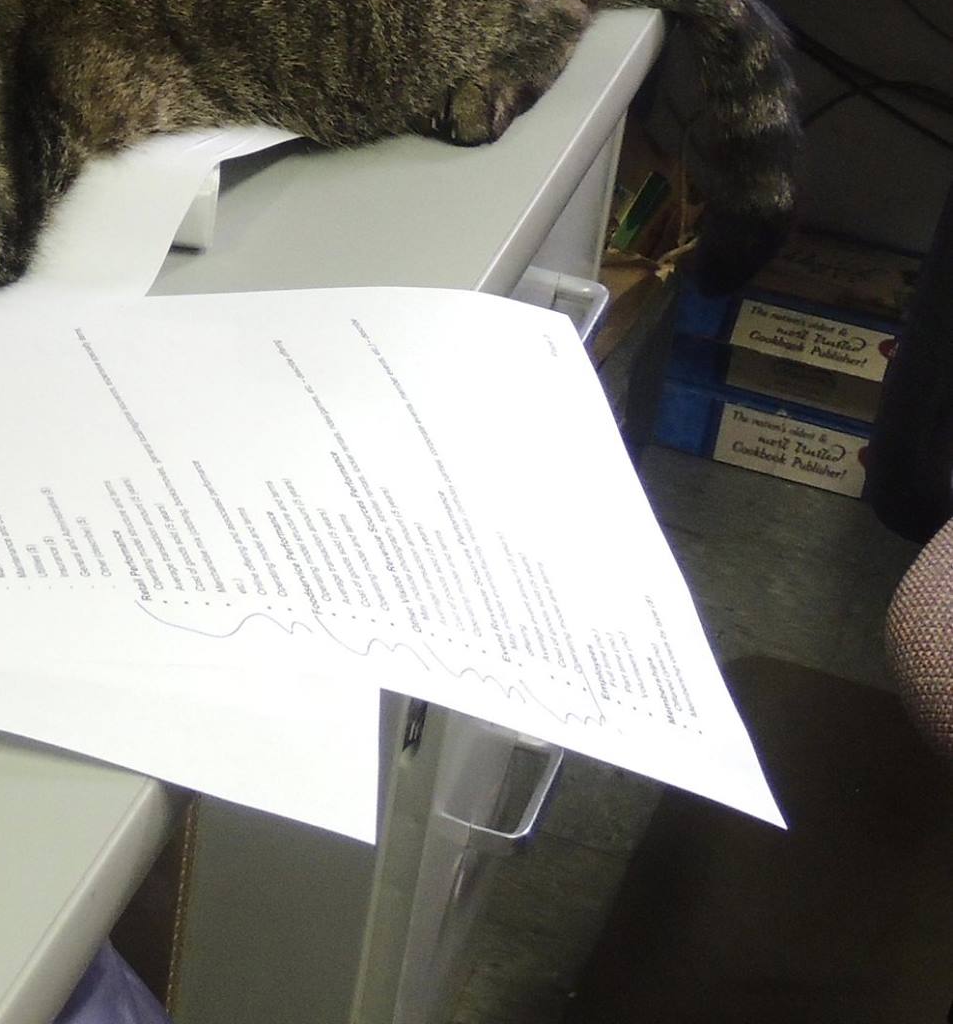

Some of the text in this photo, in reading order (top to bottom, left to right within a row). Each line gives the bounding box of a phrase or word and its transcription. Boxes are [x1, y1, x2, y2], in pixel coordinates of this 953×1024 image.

[750, 306, 768, 318] The
[749, 330, 868, 368] Cookbook Publisher!
[732, 410, 749, 423] The
[751, 418, 786, 433] nation's
[330, 451, 360, 498] Performance
[732, 441, 848, 479] Cookbook Publisher!
[357, 500, 378, 533] Sources
[113, 530, 140, 577] Performance
[267, 511, 323, 615] Foodservice Performance
